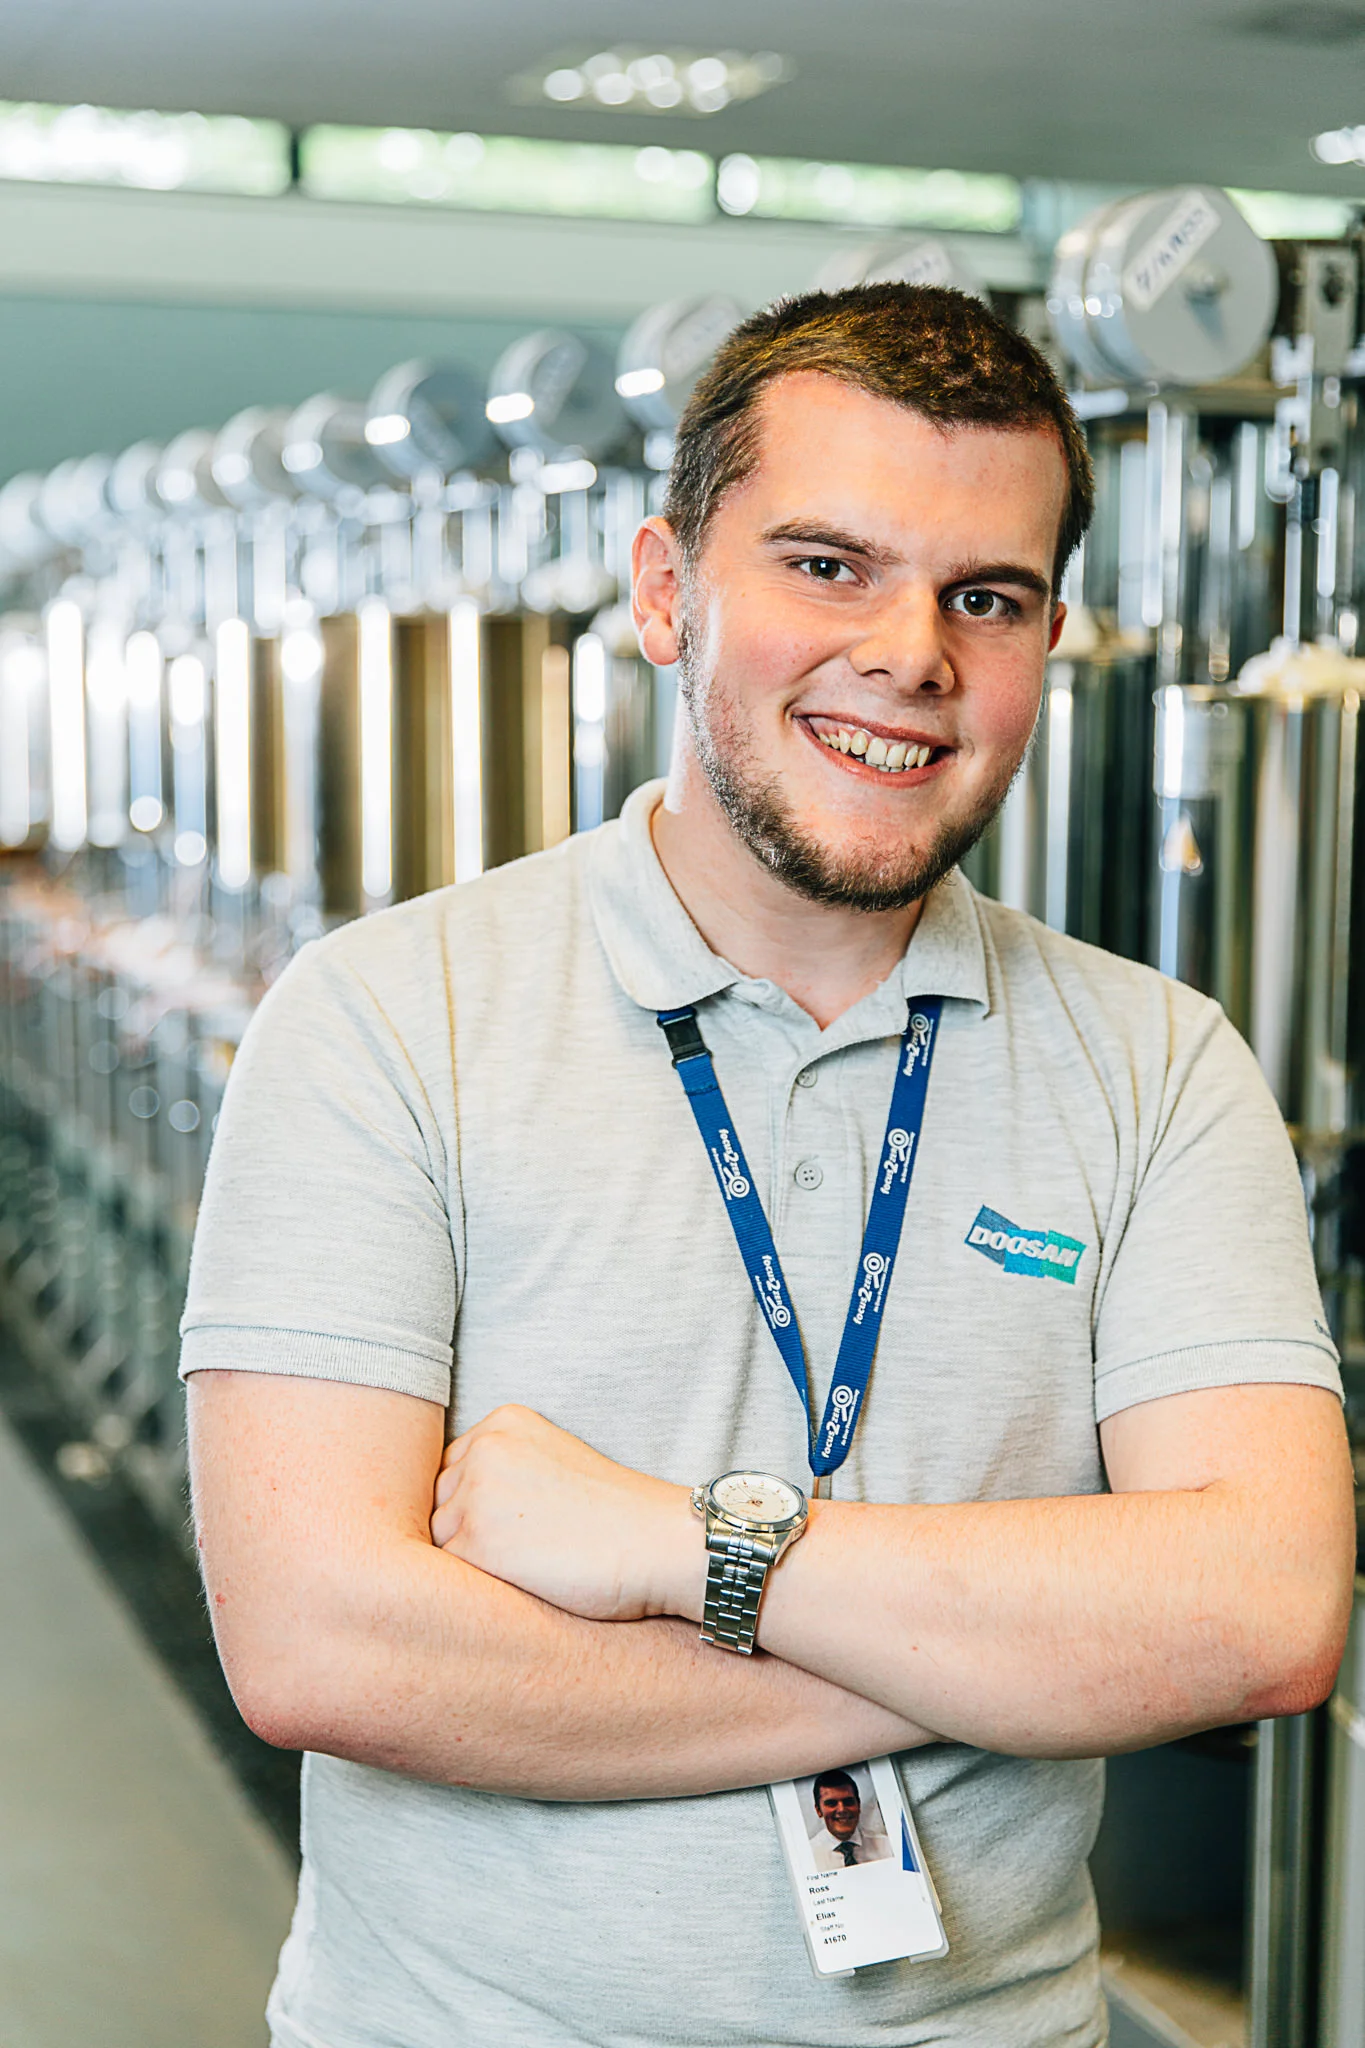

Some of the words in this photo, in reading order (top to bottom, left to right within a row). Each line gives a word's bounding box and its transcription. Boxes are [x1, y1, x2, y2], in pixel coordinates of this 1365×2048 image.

[969, 1226, 1079, 1267] DOOSAN
[809, 1885, 830, 1895] Ross
[814, 1898, 826, 1906] Last
[827, 1895, 844, 1903] Name
[816, 1911, 836, 1921] Elias
[823, 1934, 847, 1944] 41670
